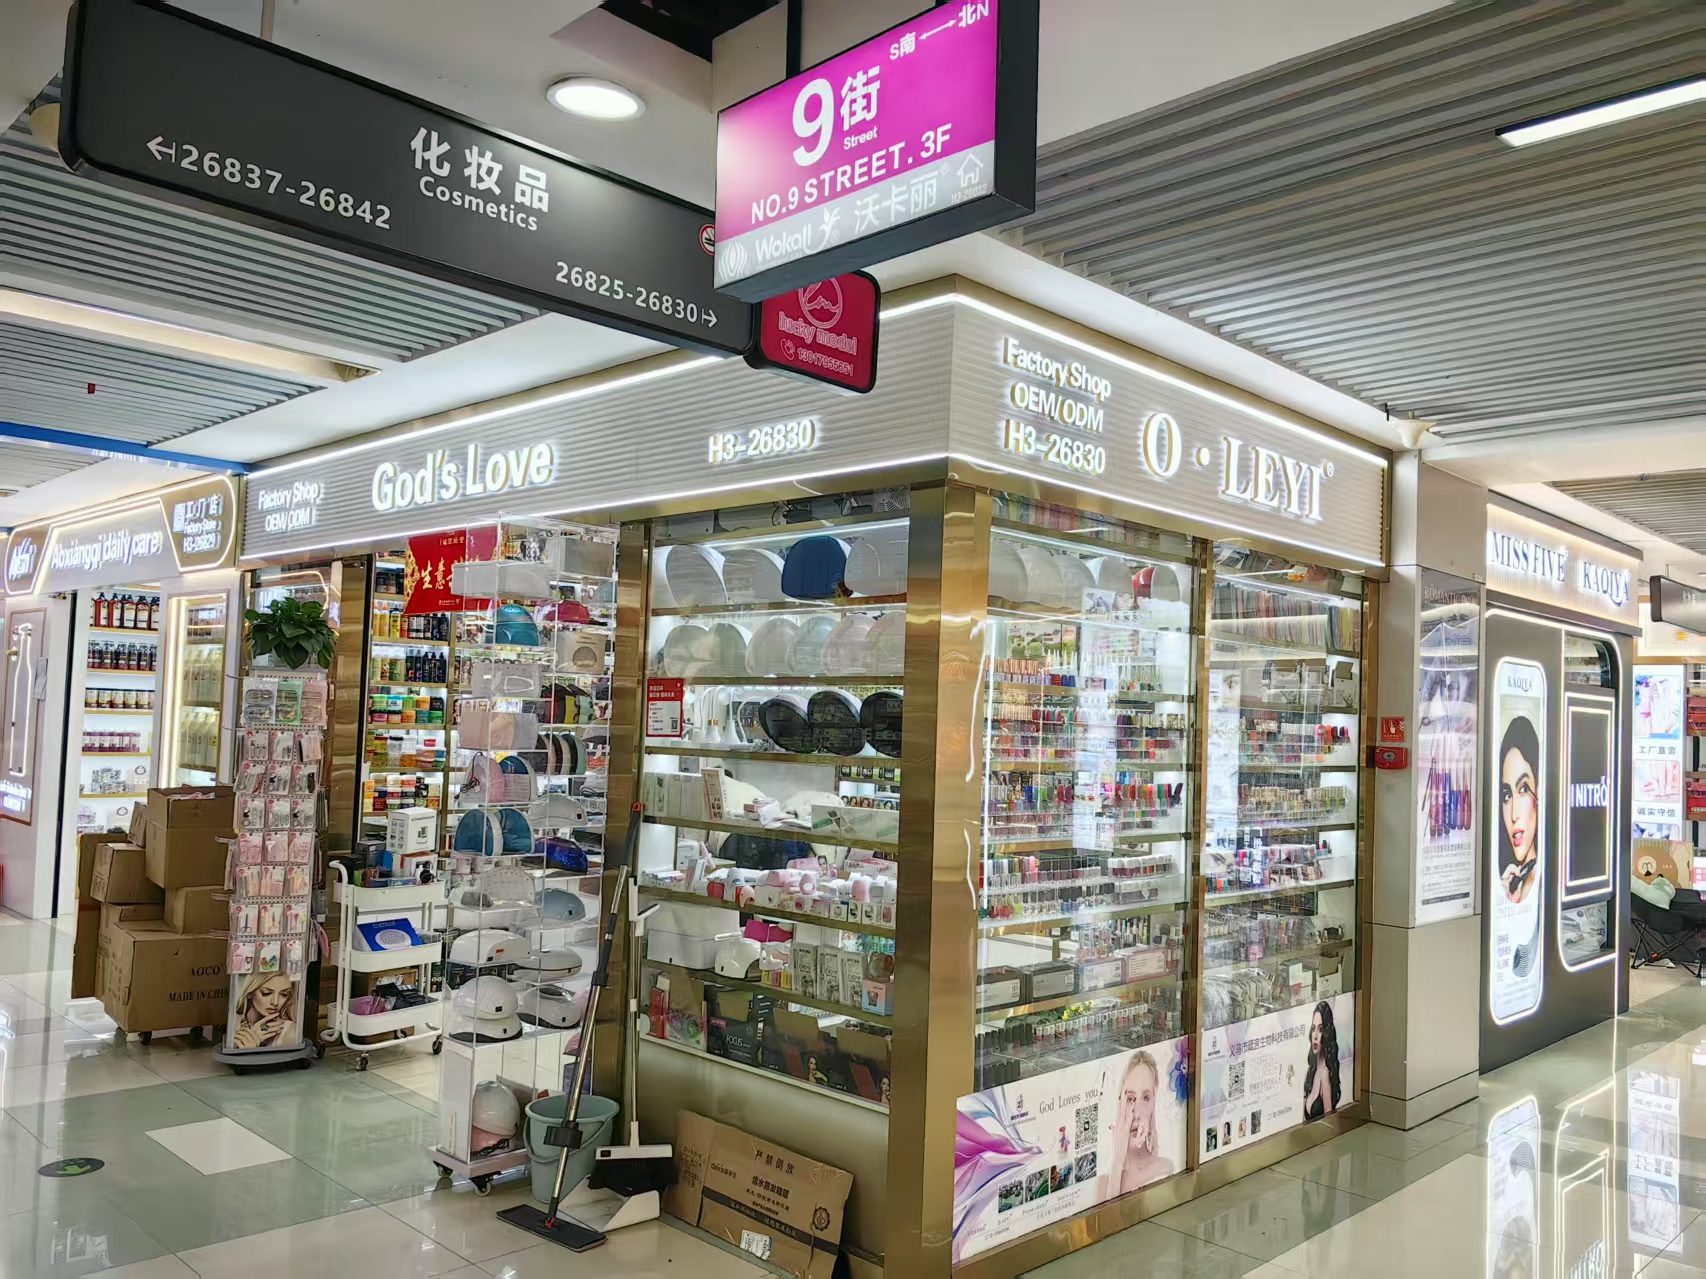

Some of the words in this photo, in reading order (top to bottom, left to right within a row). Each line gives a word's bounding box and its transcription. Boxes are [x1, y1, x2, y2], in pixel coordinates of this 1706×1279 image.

[889, 32, 917, 60] S南
[958, 0, 989, 28] 北N
[843, 126, 878, 150] Street
[180, 144, 392, 230] 26837-26842
[410, 126, 549, 213] 化妆品
[751, 186, 799, 224] NO.9
[920, 123, 952, 159] 3F
[418, 176, 538, 232] Cosmetics
[854, 170, 938, 234] 沃卡丽
[555, 261, 698, 324] 26825-26830
[778, 311, 816, 344] lucky
[815, 327, 858, 356] model
[1003, 337, 1068, 388] Factory
[1066, 361, 1111, 403] Shop
[1010, 382, 1104, 432] OEM/ODM
[708, 419, 816, 464] H3-26830
[1004, 419, 1106, 473] H3-26830
[258, 487, 293, 511] Factory
[293, 481, 320, 505] Shop
[372, 450, 461, 511] God's
[465, 443, 555, 496] Love
[102, 530, 131, 564] daily
[132, 532, 162, 556] care
[1491, 531, 1530, 572] MISS
[1531, 544, 1565, 583] FIVE
[1583, 560, 1630, 608] KAQIYA
[169, 991, 194, 1001] MADE
[196, 991, 205, 1001] IN
[726, 1034, 743, 1047] FOCUS
[1039, 1098, 1055, 1114] God
[1058, 1093, 1081, 1109] Loves
